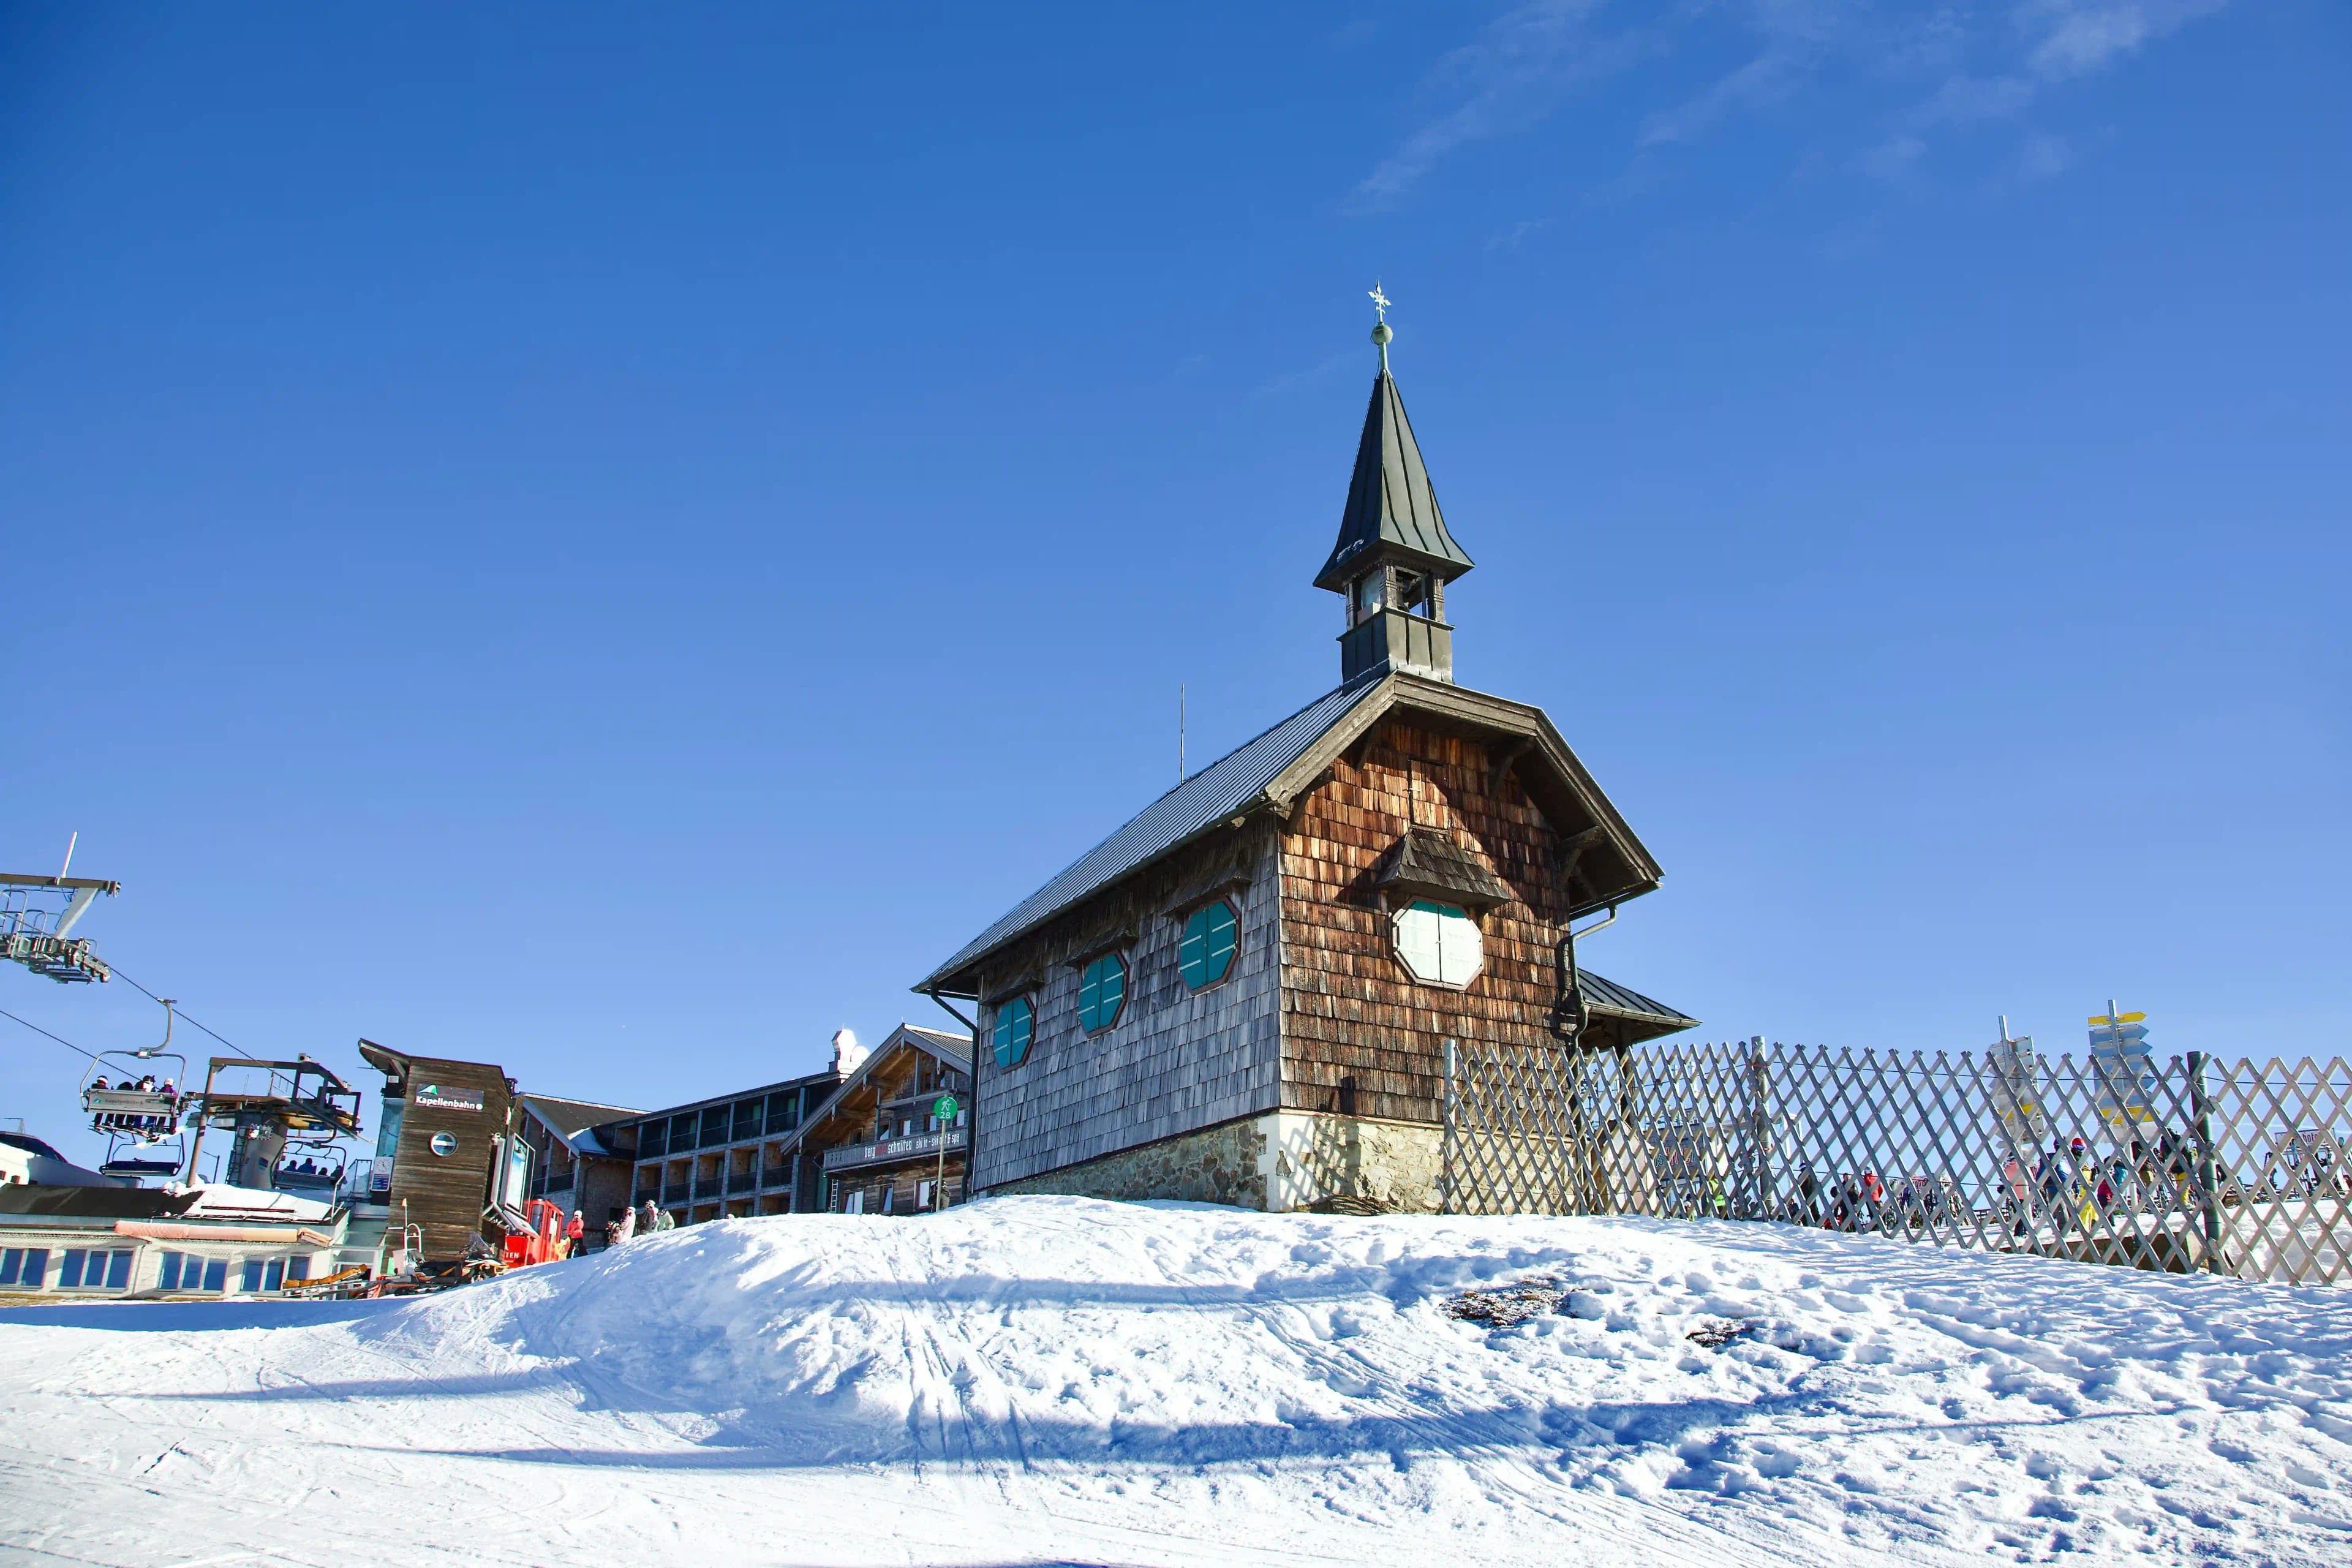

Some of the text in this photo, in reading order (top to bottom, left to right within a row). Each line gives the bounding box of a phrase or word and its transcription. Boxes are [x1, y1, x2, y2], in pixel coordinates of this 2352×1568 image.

[415, 1095, 475, 1110] Kapellenbahn
[888, 1139, 912, 1154] schmitten
[924, 1137, 928, 1148] in
[951, 1133, 960, 1145] spa
